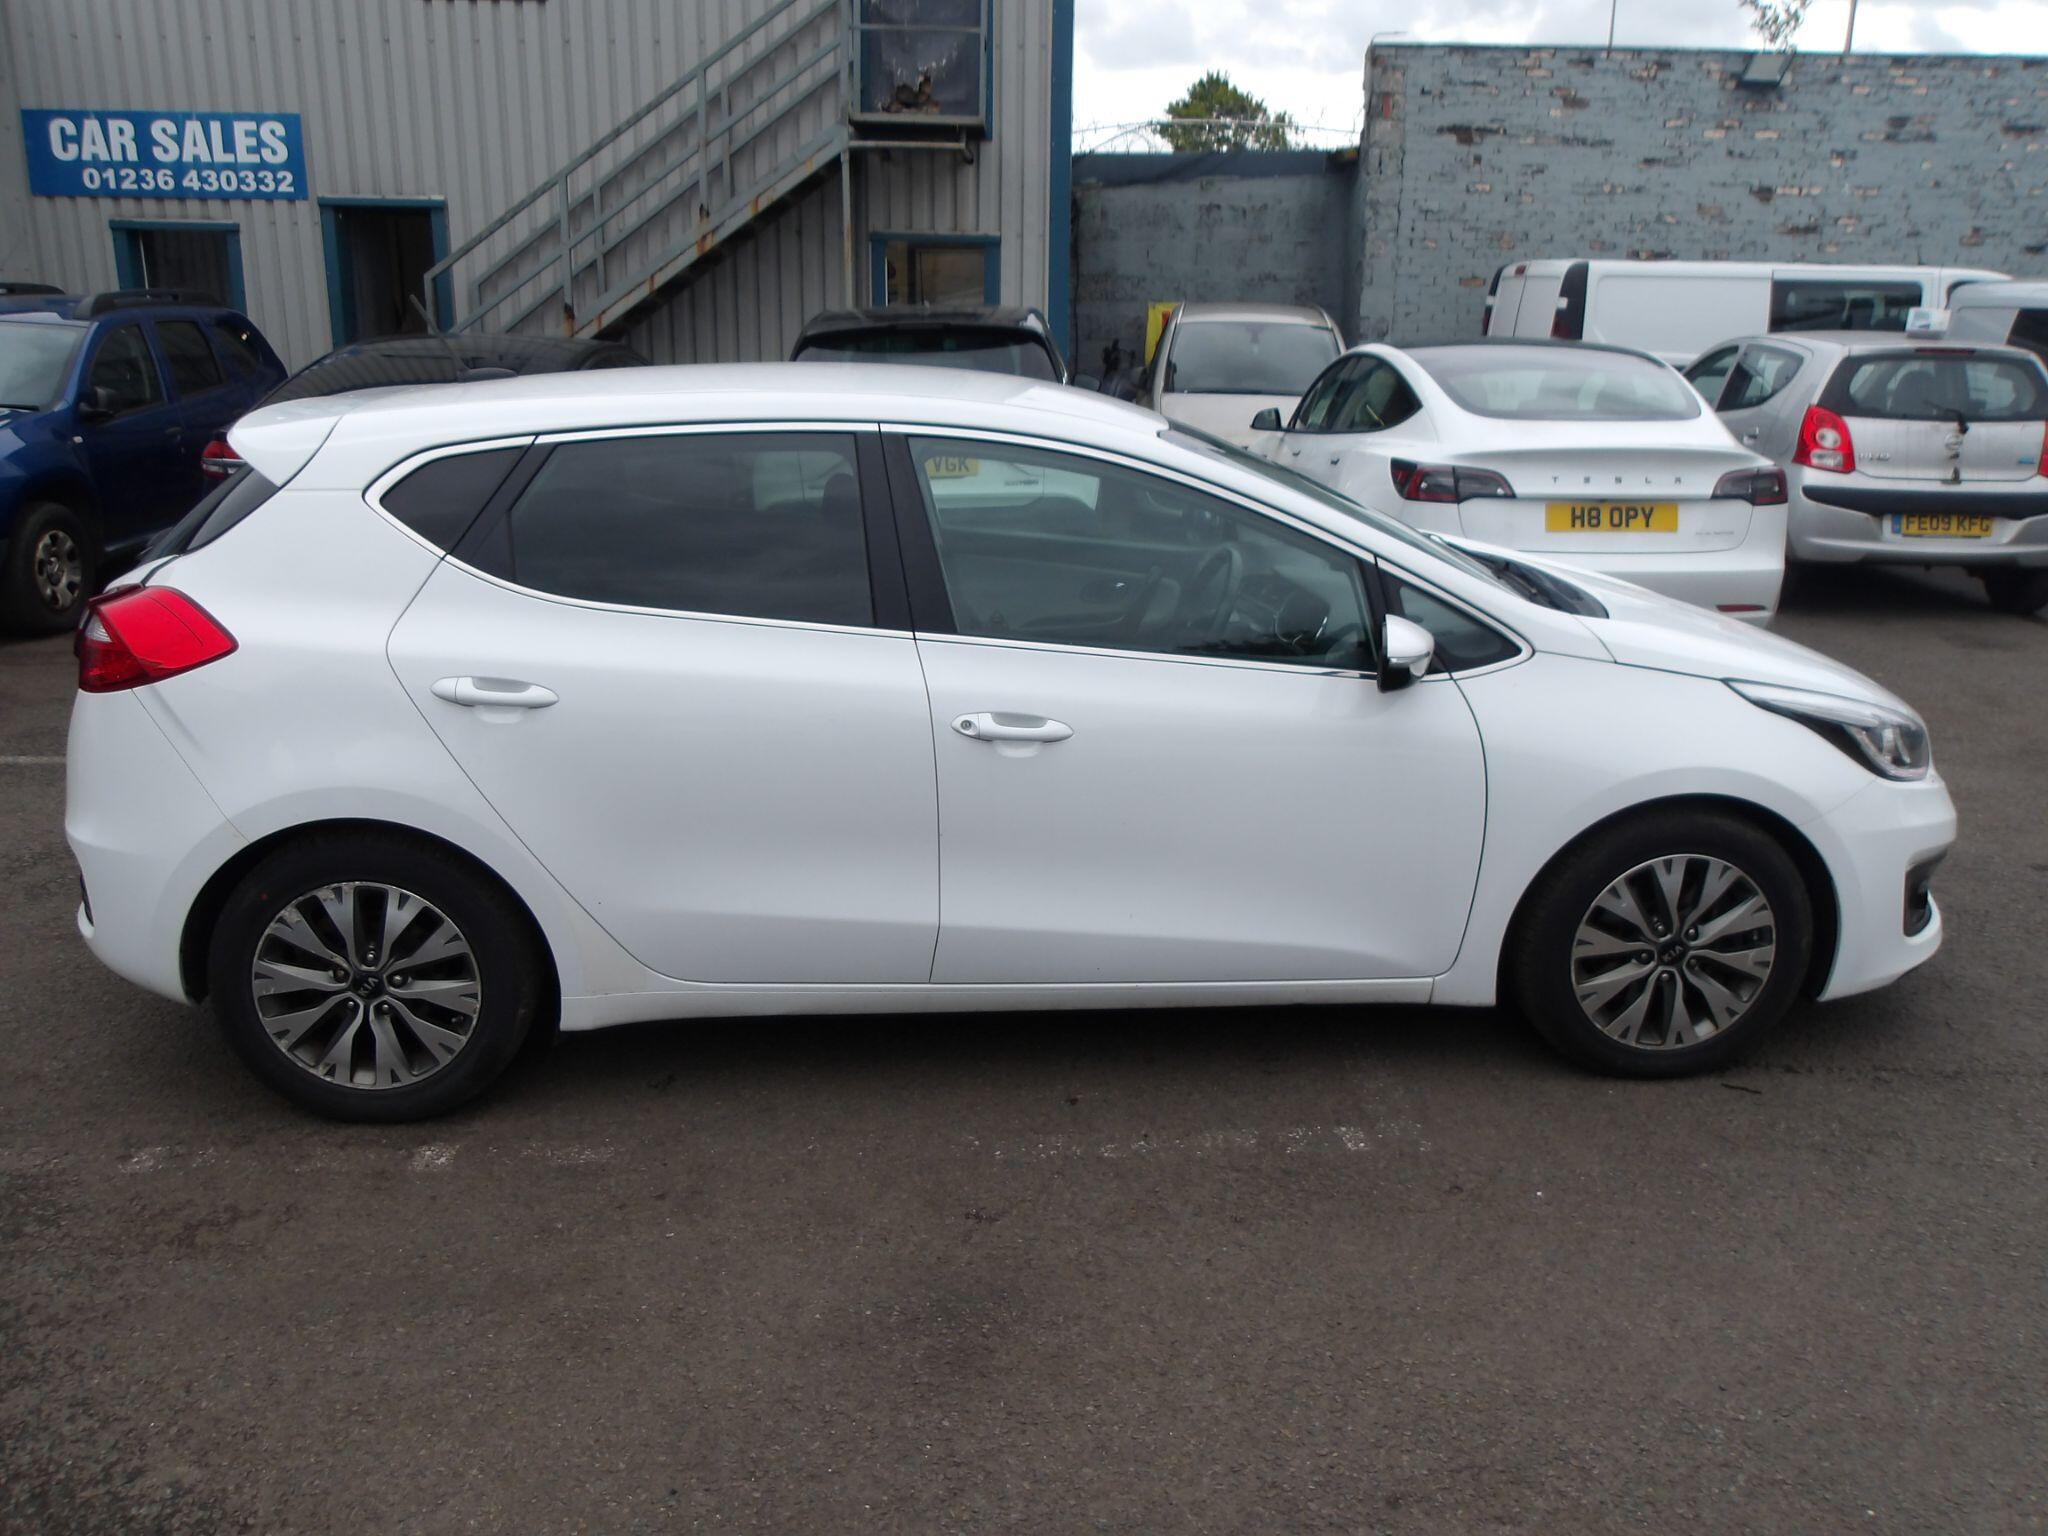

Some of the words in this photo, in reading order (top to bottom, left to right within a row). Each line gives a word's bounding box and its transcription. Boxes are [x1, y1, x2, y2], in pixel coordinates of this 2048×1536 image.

[49, 117, 139, 162] CAR
[150, 119, 289, 164] SALES
[82, 167, 175, 191] 01236
[182, 169, 295, 193] 430332
[358, 977, 379, 997] KIA
